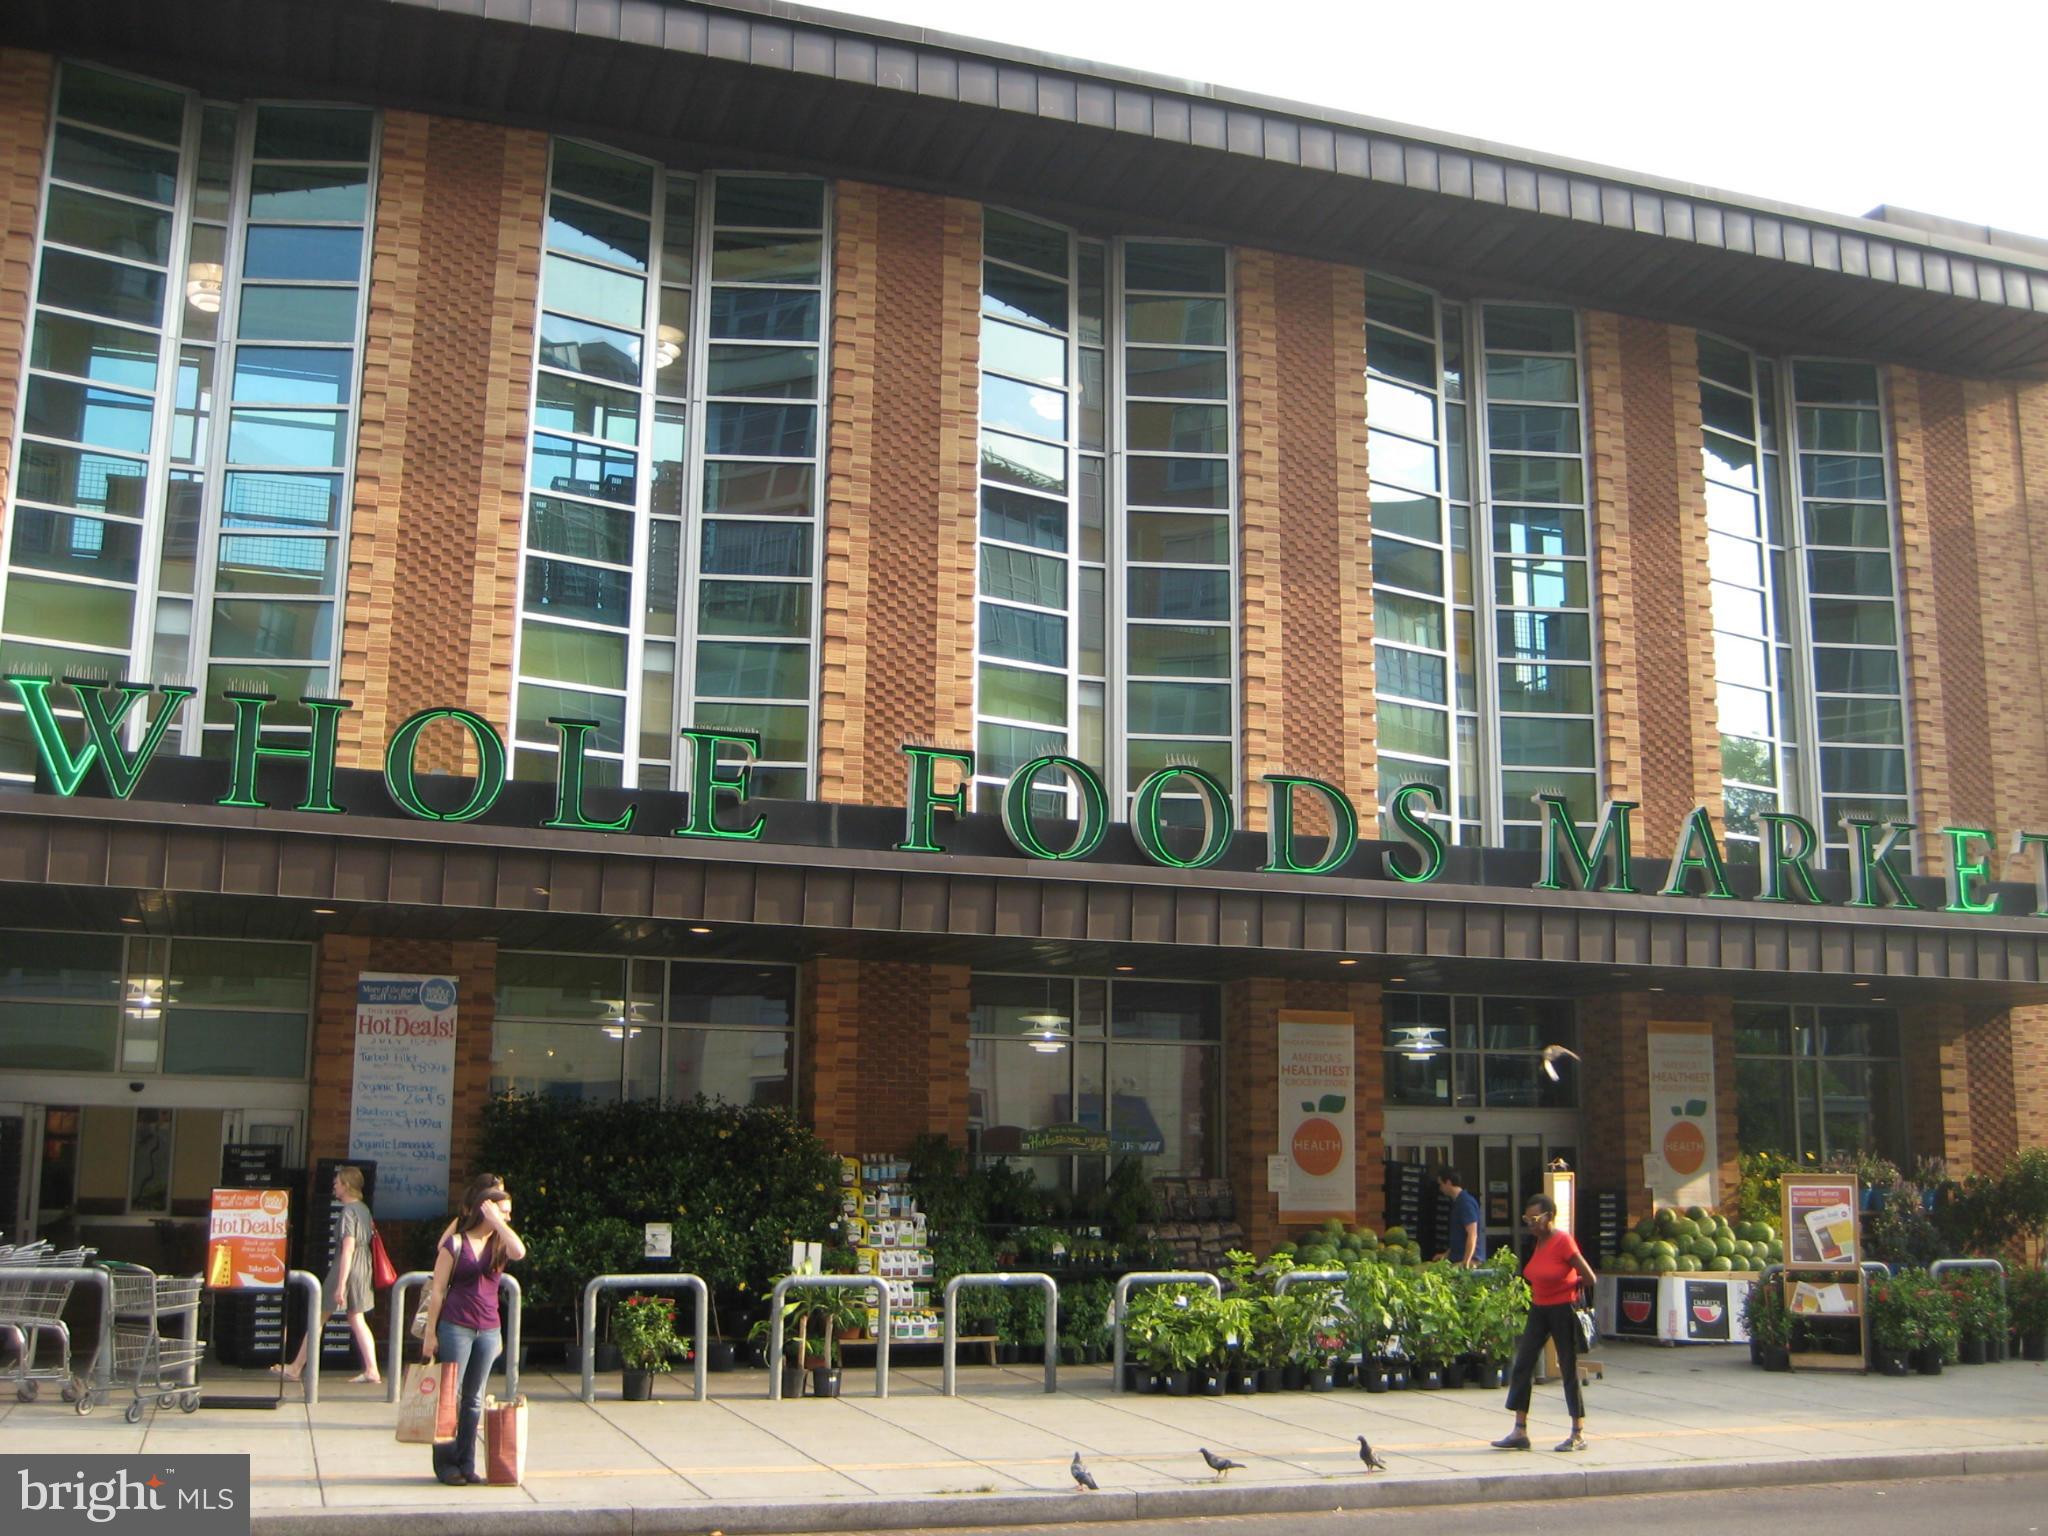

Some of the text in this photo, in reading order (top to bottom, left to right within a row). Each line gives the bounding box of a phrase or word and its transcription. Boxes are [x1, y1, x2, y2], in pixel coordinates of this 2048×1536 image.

[3, 674, 768, 841] WHOLE
[893, 743, 1446, 886] FOODS
[358, 1014, 456, 1038] Hot Deals!
[1291, 1052, 1343, 1063] AMERICA'S
[1281, 1065, 1351, 1076] HEALTHIEST
[1652, 1072, 1712, 1083] HEALTHIEST
[1294, 1140, 1341, 1151] HEALTH
[1665, 1141, 1704, 1151] HEALTH
[211, 1217, 238, 1233] Hot
